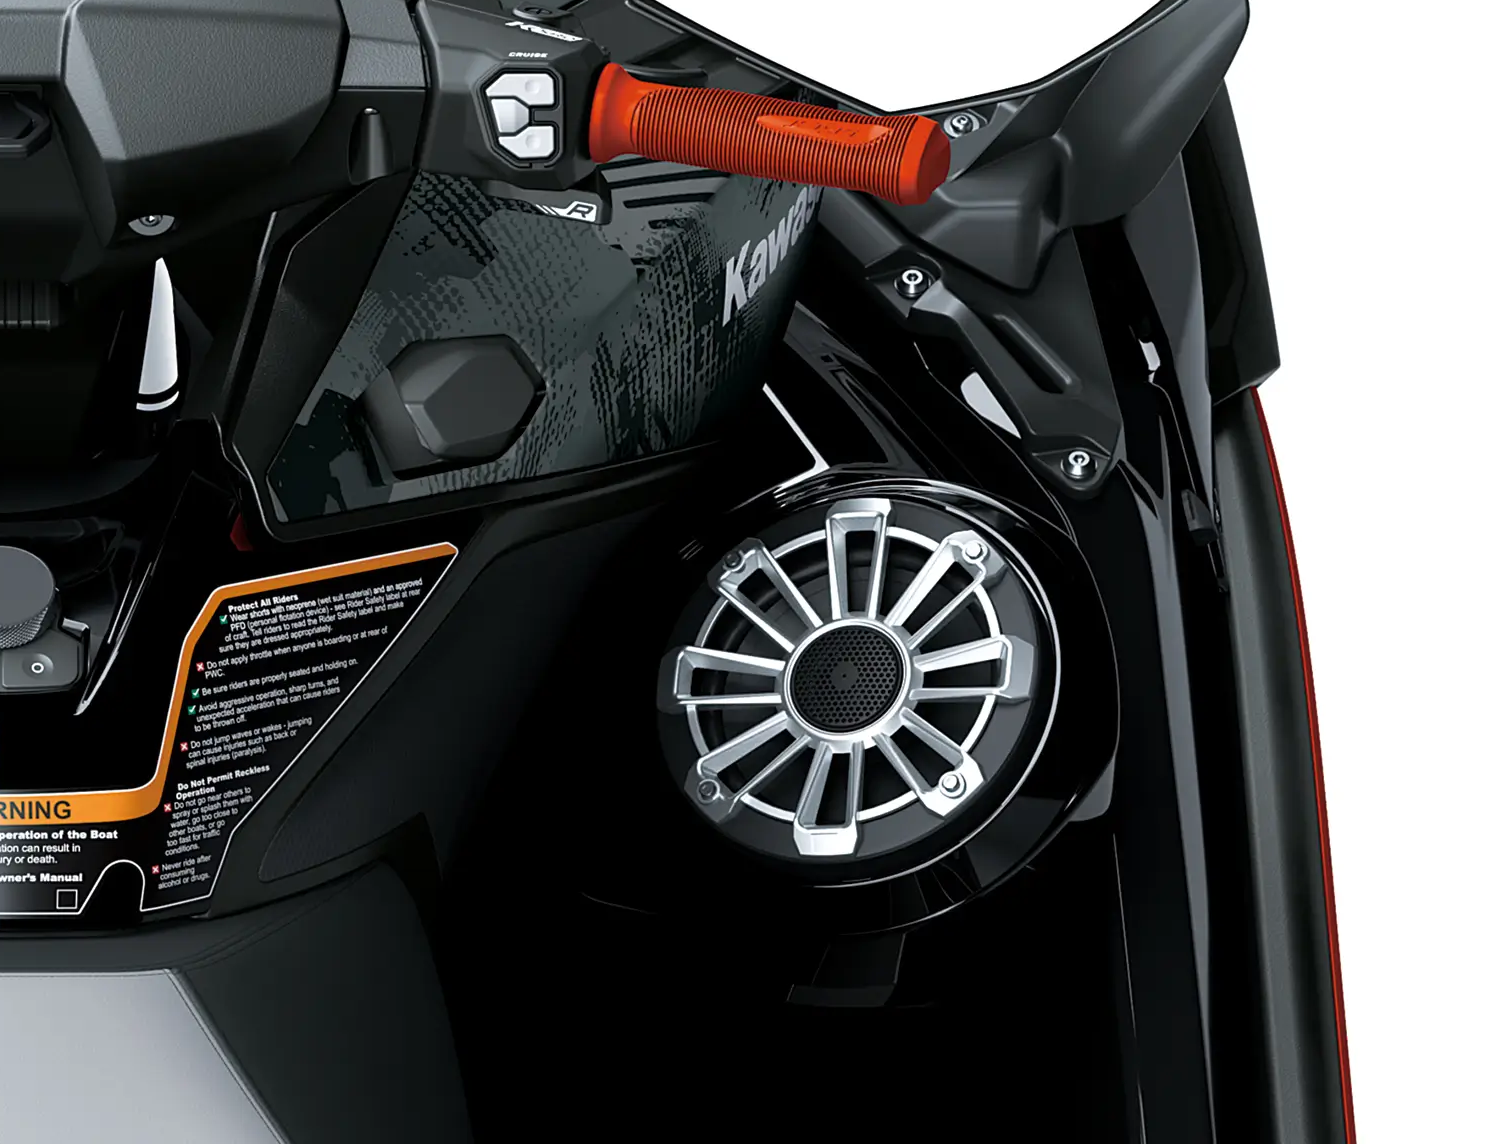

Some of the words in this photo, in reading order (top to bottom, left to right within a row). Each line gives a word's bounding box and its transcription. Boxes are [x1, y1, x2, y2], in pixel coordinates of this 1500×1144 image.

[228, 601, 259, 613] Protect
[261, 598, 271, 607] All
[272, 595, 299, 604] Riders
[178, 783, 189, 791] Do
[190, 779, 205, 788] Not
[207, 772, 233, 784] Permit
[235, 765, 270, 778] Reckless
[52, 830, 64, 839] of
[67, 830, 87, 839] the
[90, 830, 118, 839] Boat
[42, 844, 70, 852] result
[72, 844, 80, 852] in
[14, 856, 24, 864] or
[27, 855, 58, 864] death.
[40, 873, 82, 882] Manual
